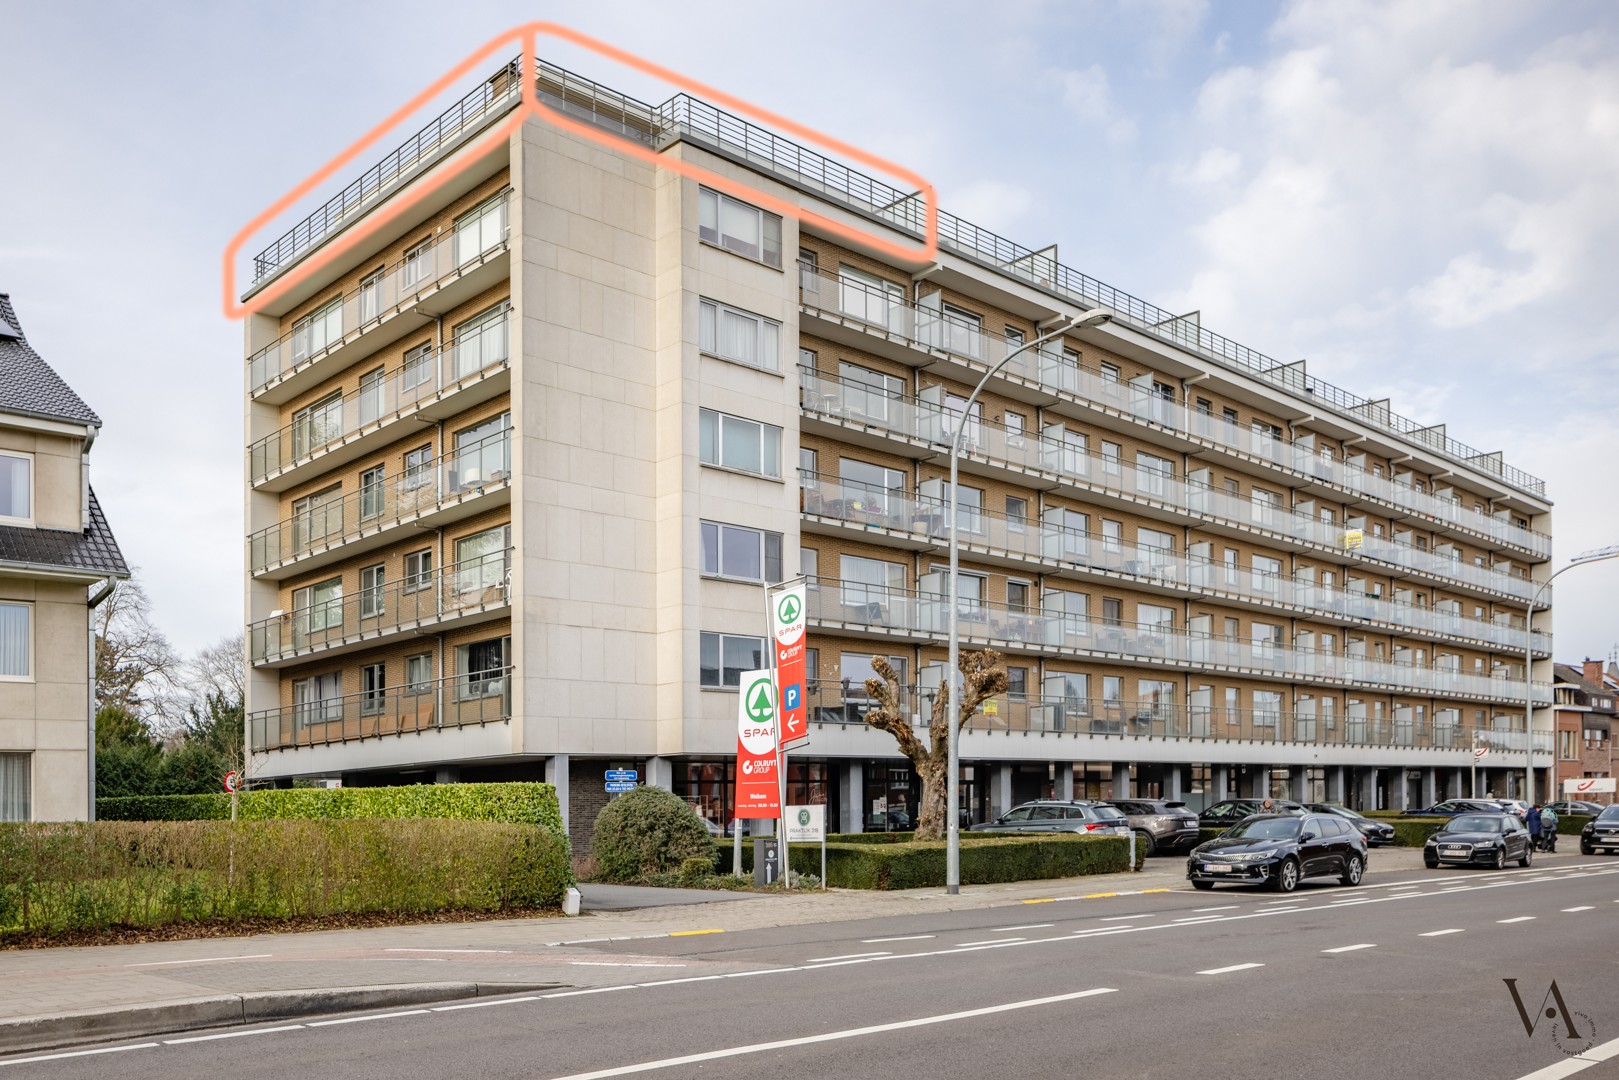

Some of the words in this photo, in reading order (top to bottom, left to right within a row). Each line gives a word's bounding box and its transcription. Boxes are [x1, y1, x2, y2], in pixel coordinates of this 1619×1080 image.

[778, 624, 802, 637] SPAR
[753, 759, 777, 767] COLRUYT
[753, 766, 770, 774] GROUP
